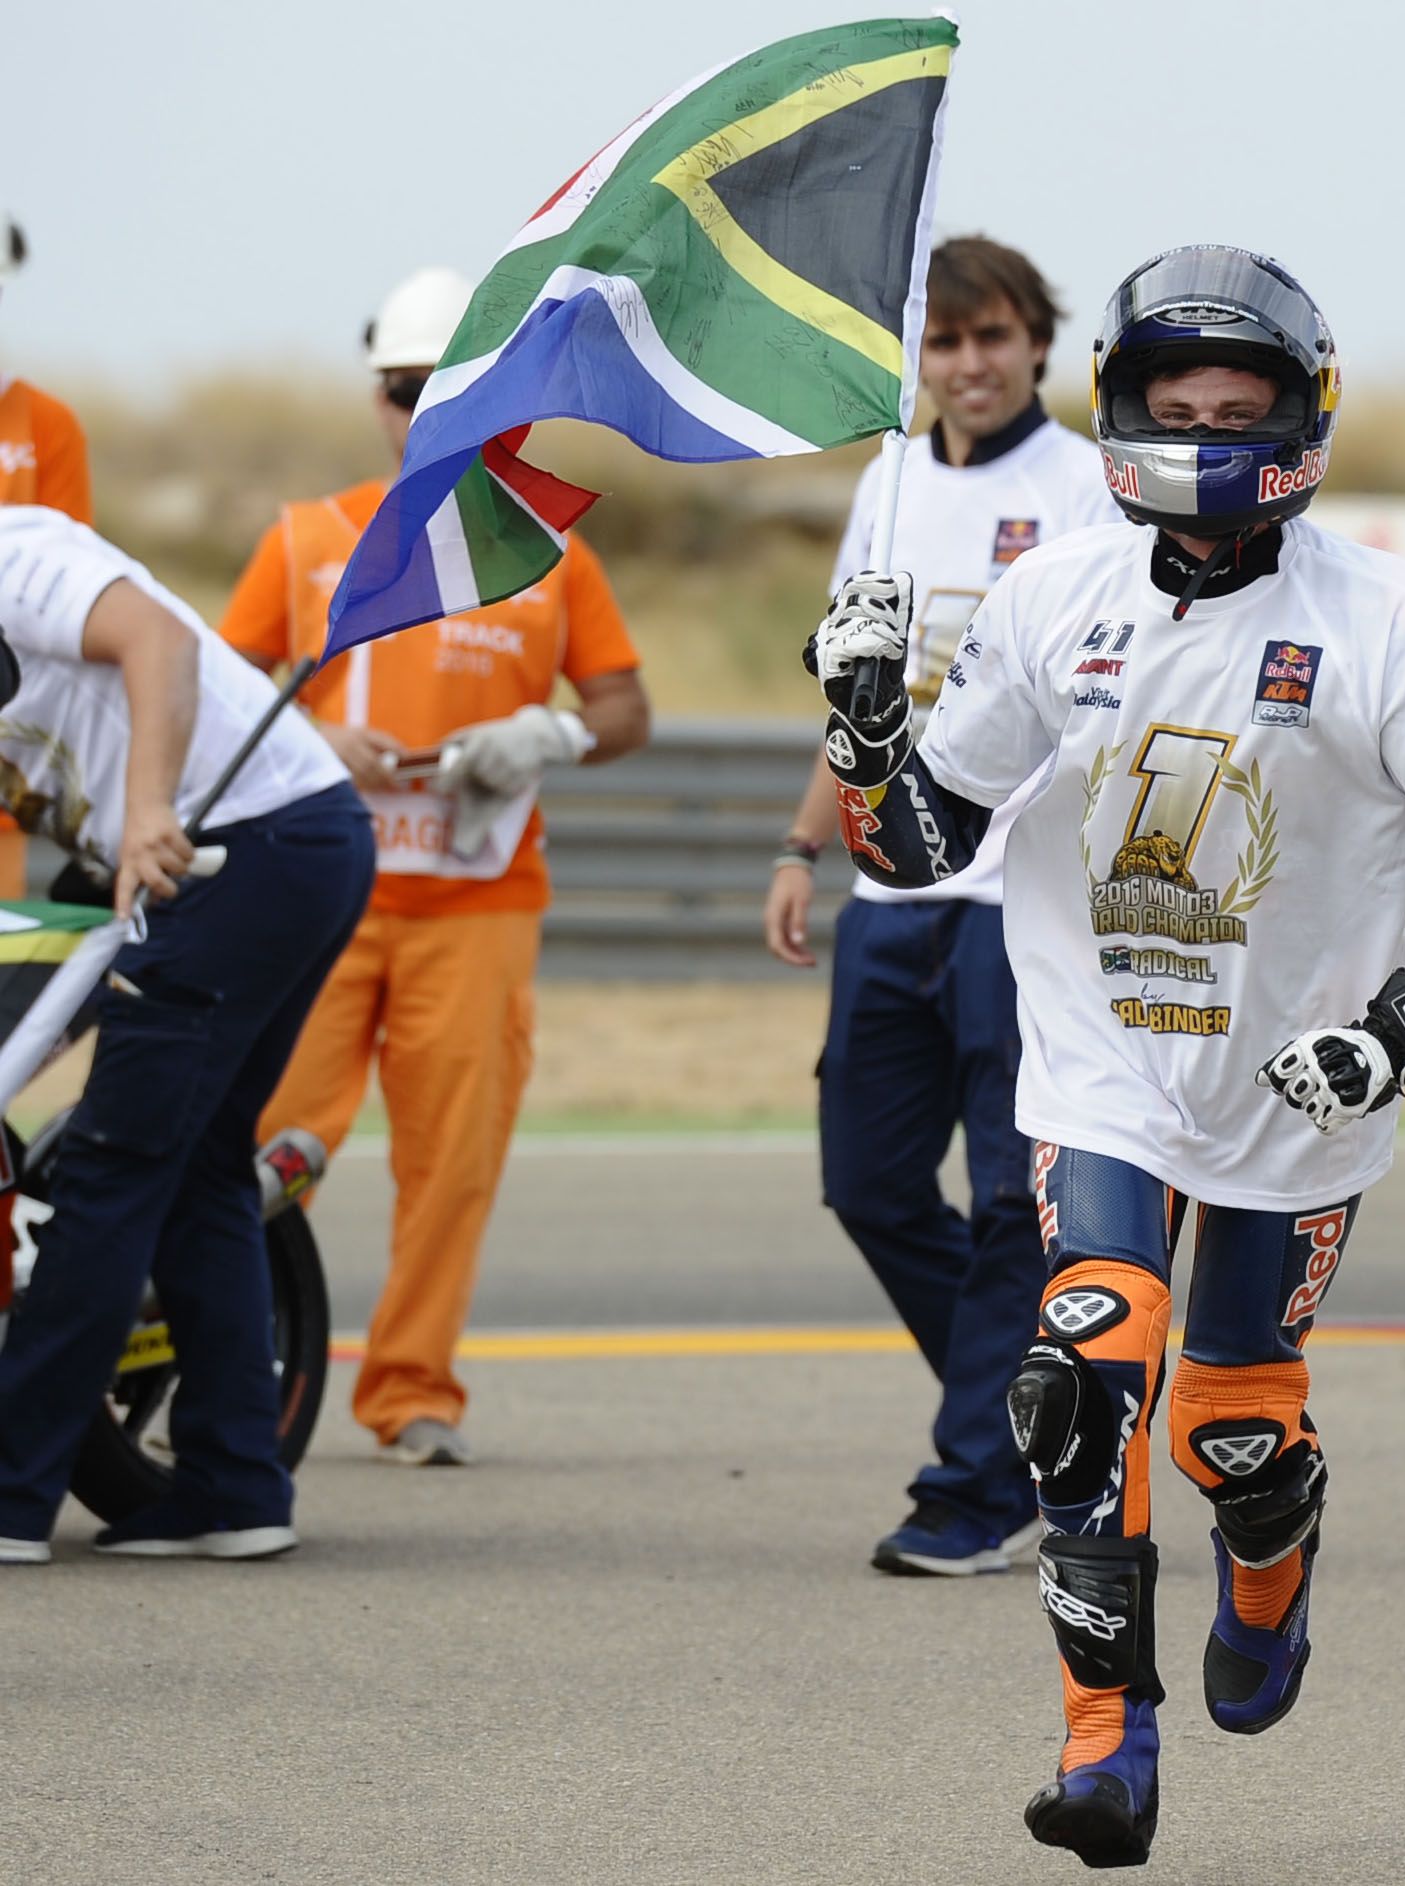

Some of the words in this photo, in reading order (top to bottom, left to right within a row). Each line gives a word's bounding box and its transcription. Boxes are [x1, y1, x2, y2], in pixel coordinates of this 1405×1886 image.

[1182, 314, 1218, 322] HELMET
[1077, 620, 1136, 655] 41
[1263, 681, 1308, 703] KTM
[1095, 876, 1142, 907] 2016
[1147, 878, 1217, 916] MOTO3
[1141, 905, 1247, 946] CHAMPION
[1130, 948, 1217, 983] RADICAL
[1149, 1003, 1232, 1036] BINDER
[1280, 1205, 1348, 1328] Red
[1053, 1433, 1082, 1477] IXON
